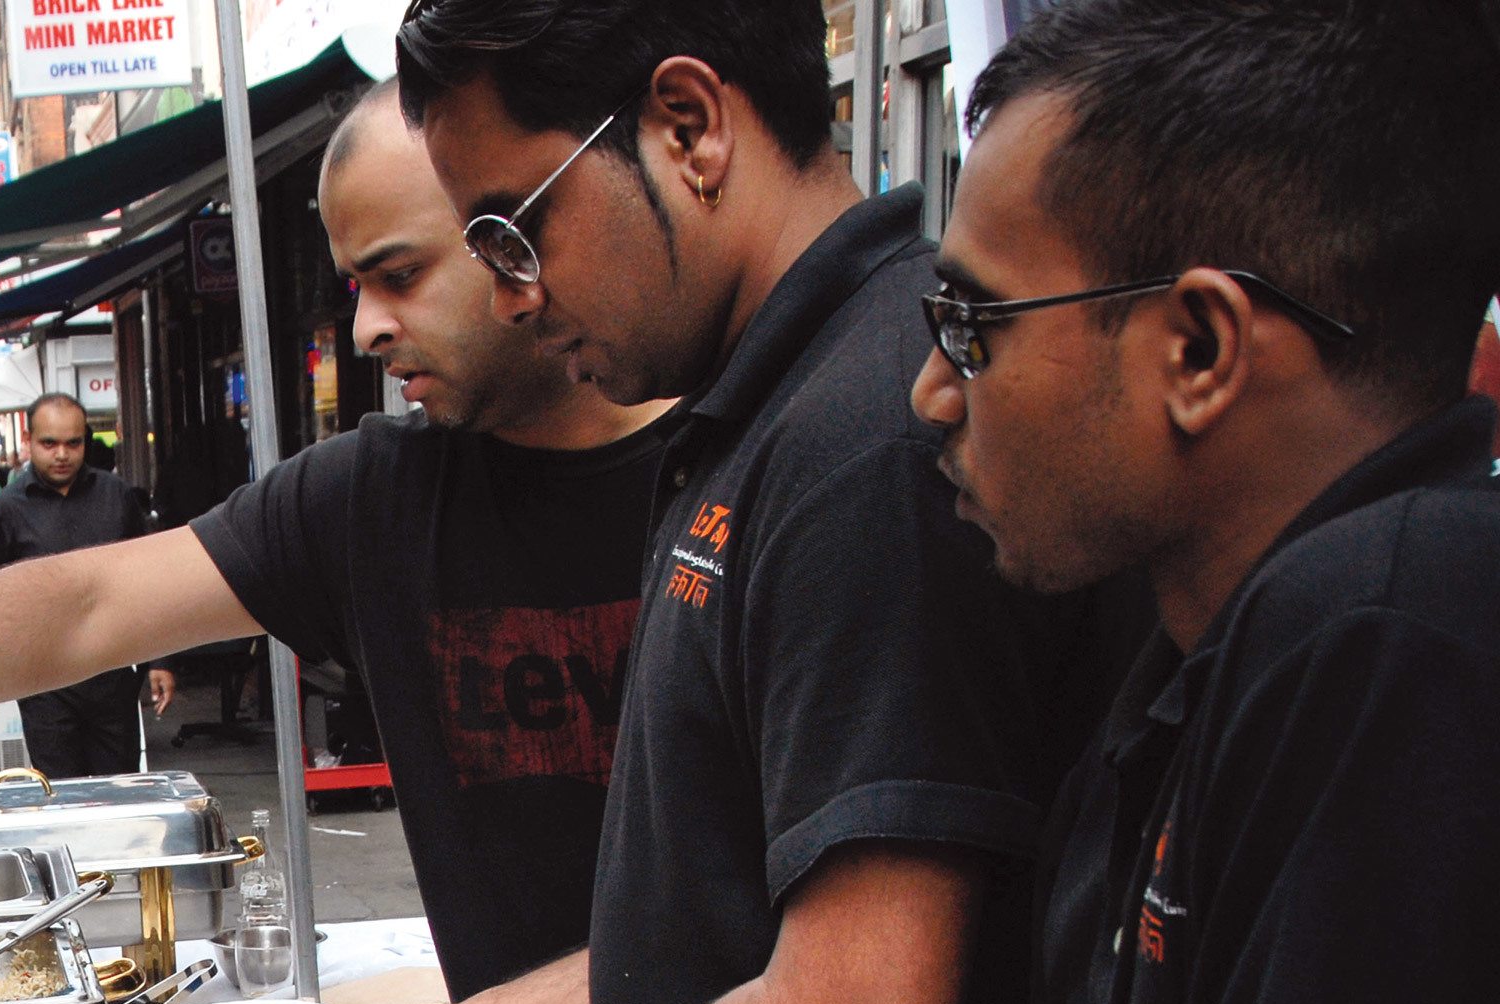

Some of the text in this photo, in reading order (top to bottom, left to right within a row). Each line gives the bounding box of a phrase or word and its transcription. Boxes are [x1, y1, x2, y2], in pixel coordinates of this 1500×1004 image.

[24, 16, 175, 50] MINI MARKET
[49, 55, 157, 77] OPEN TILL LATE
